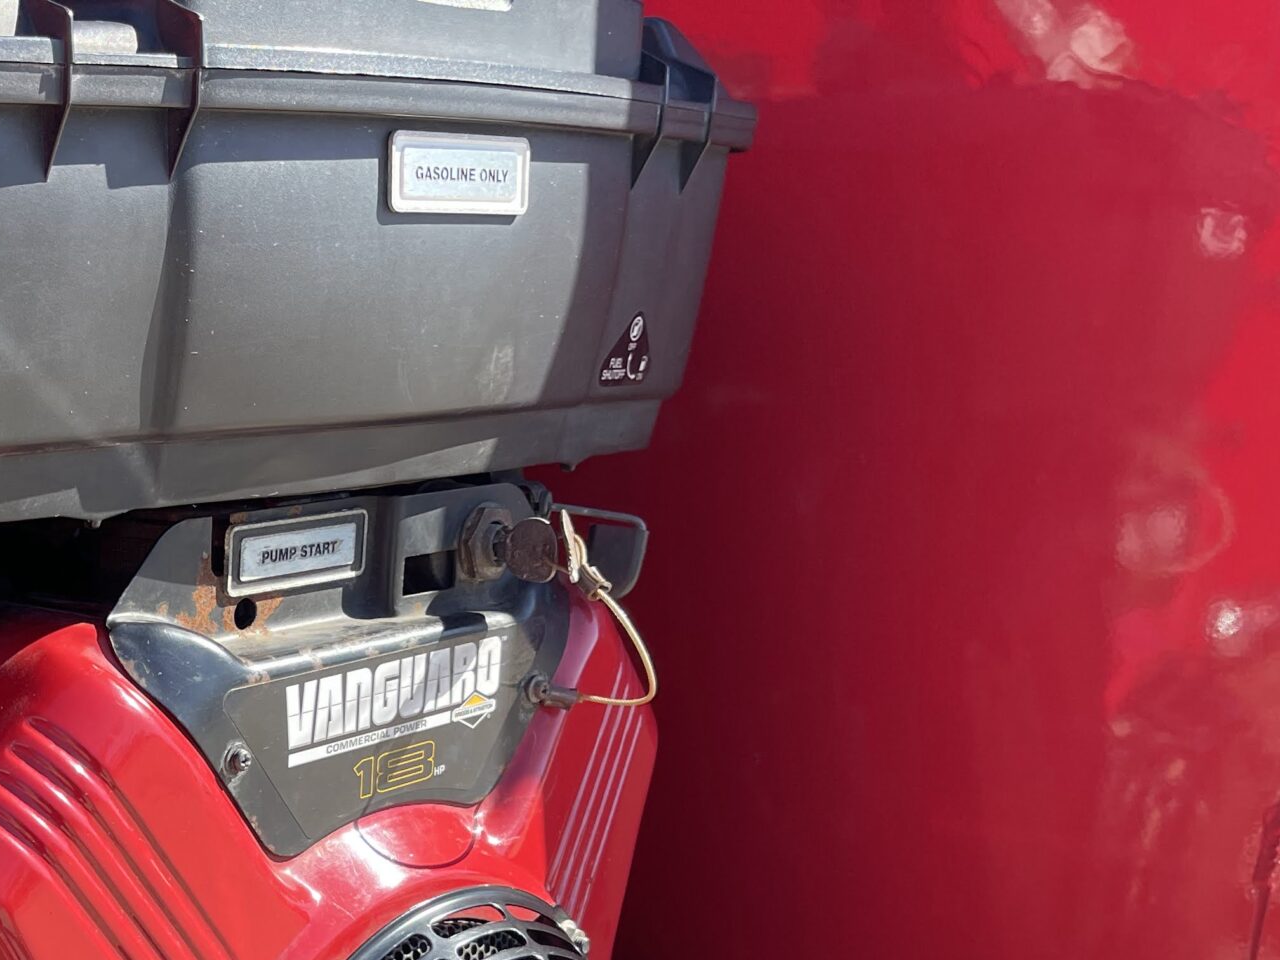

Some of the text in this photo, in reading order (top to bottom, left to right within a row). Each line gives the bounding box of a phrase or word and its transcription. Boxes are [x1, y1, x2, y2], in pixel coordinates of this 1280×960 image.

[415, 166, 509, 183] GASOLINE ONLY
[261, 540, 338, 564] PUMP START
[285, 635, 502, 750] VANGUARD
[326, 718, 427, 754] COMMERCIAL POWER
[353, 740, 446, 799] 18 HP
